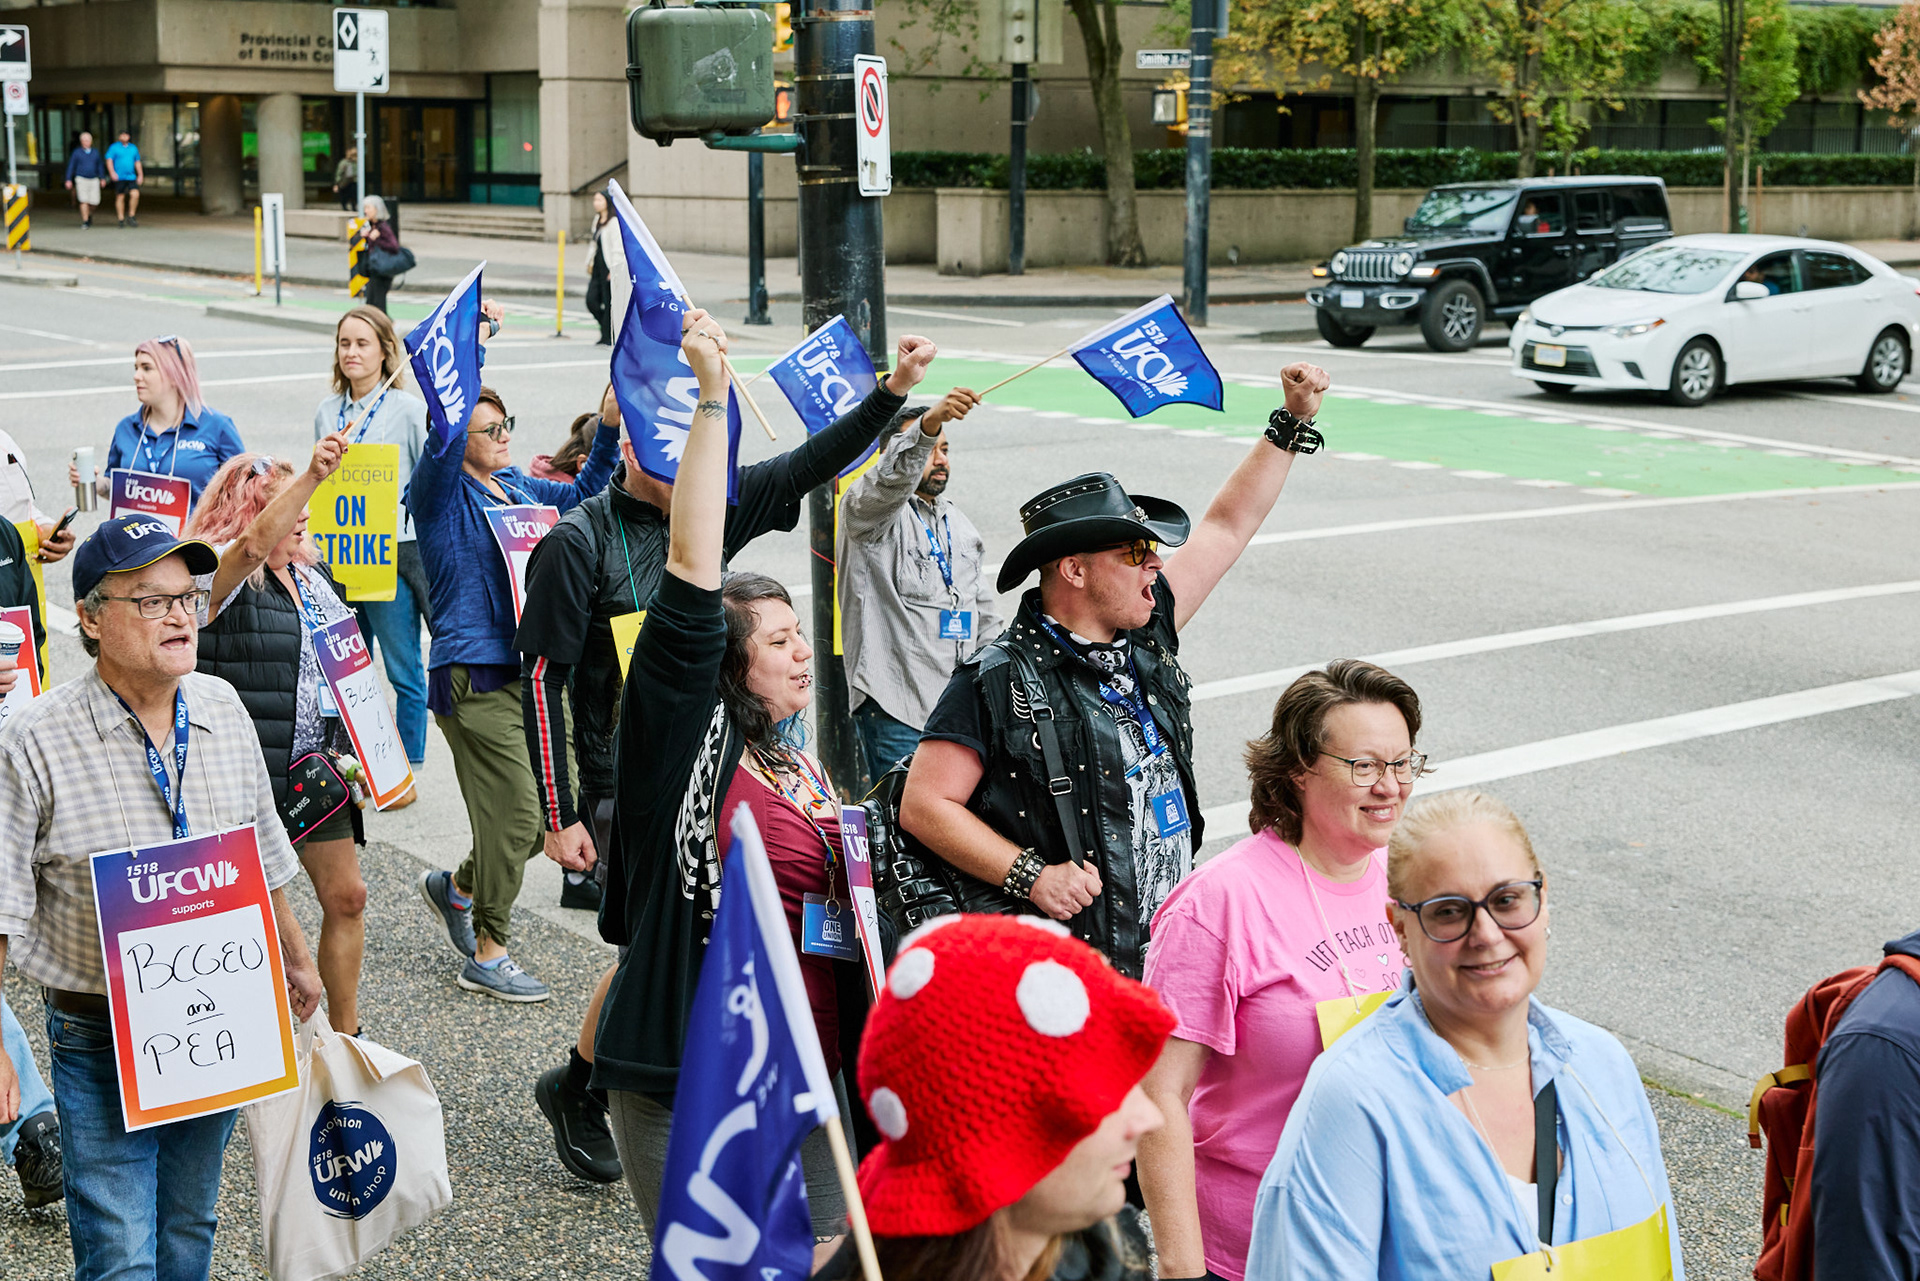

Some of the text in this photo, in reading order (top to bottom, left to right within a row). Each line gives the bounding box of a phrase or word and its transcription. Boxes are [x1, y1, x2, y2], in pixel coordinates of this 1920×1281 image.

[241, 33, 334, 47] Provincial Co
[239, 49, 252, 60] of
[261, 49, 308, 61] British
[1106, 353, 1129, 376] FIGHT
[1112, 328, 1185, 384] UFCW
[794, 367, 813, 391] FIGHT
[811, 392, 826, 411] FOR
[342, 465, 393, 486] bcgeu
[125, 484, 169, 504] UFCW
[335, 495, 366, 527] ON
[505, 521, 545, 539] UFCW
[177, 702, 188, 728] UFCW
[177, 744, 187, 769] UFCW
[289, 796, 311, 818] PARIS
[126, 861, 159, 877] 1518
[128, 860, 226, 904] UFCW
[171, 899, 215, 915] supports
[823, 932, 841, 941] UNION
[824, 920, 841, 933] ONE
[1305, 922, 1396, 972] LIFT EACH OT
[126, 938, 264, 993] BCGEU
[187, 989, 216, 1017] and
[143, 1029, 236, 1075] PEA
[313, 1149, 333, 1165] 1518
[315, 1142, 373, 1183] UFW
[363, 1165, 386, 1199] shop
